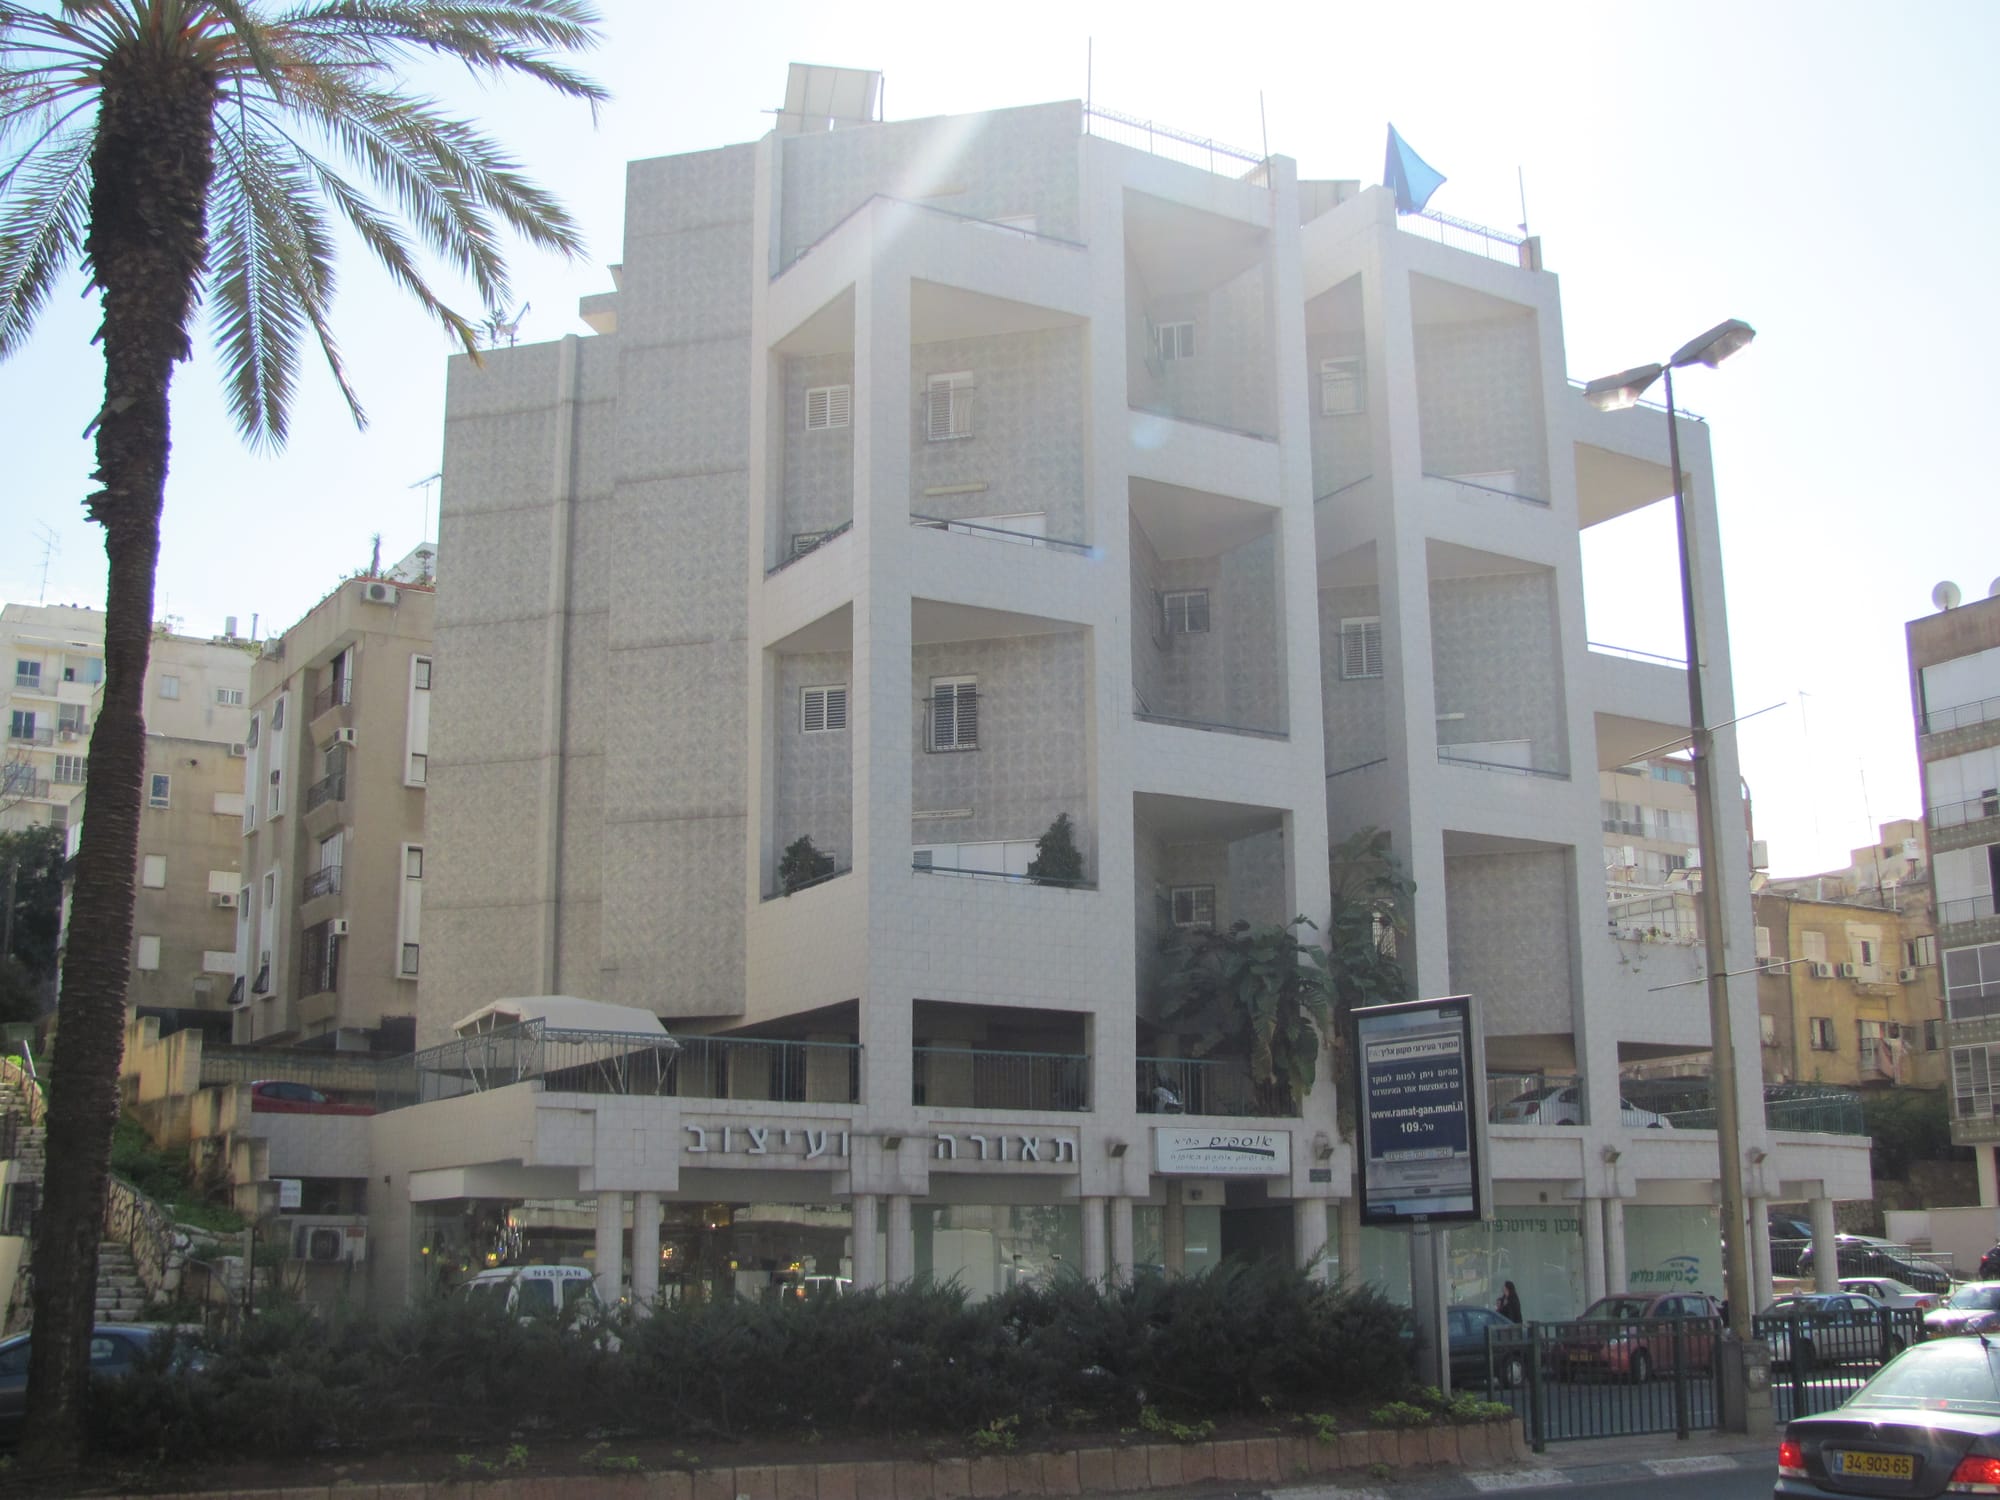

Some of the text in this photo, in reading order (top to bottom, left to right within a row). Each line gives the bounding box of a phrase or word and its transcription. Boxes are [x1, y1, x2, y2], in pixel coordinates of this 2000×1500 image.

[1371, 1068, 1458, 1086] מהיום ניתן לפנות למוקד
[1370, 1100, 1464, 1120] www.ramat-gan.muni.il
[686, 1124, 1078, 1163] תאורה ועיצוב
[1552, 1217, 1579, 1235] מכון
[533, 1269, 582, 1277] NISSAN
